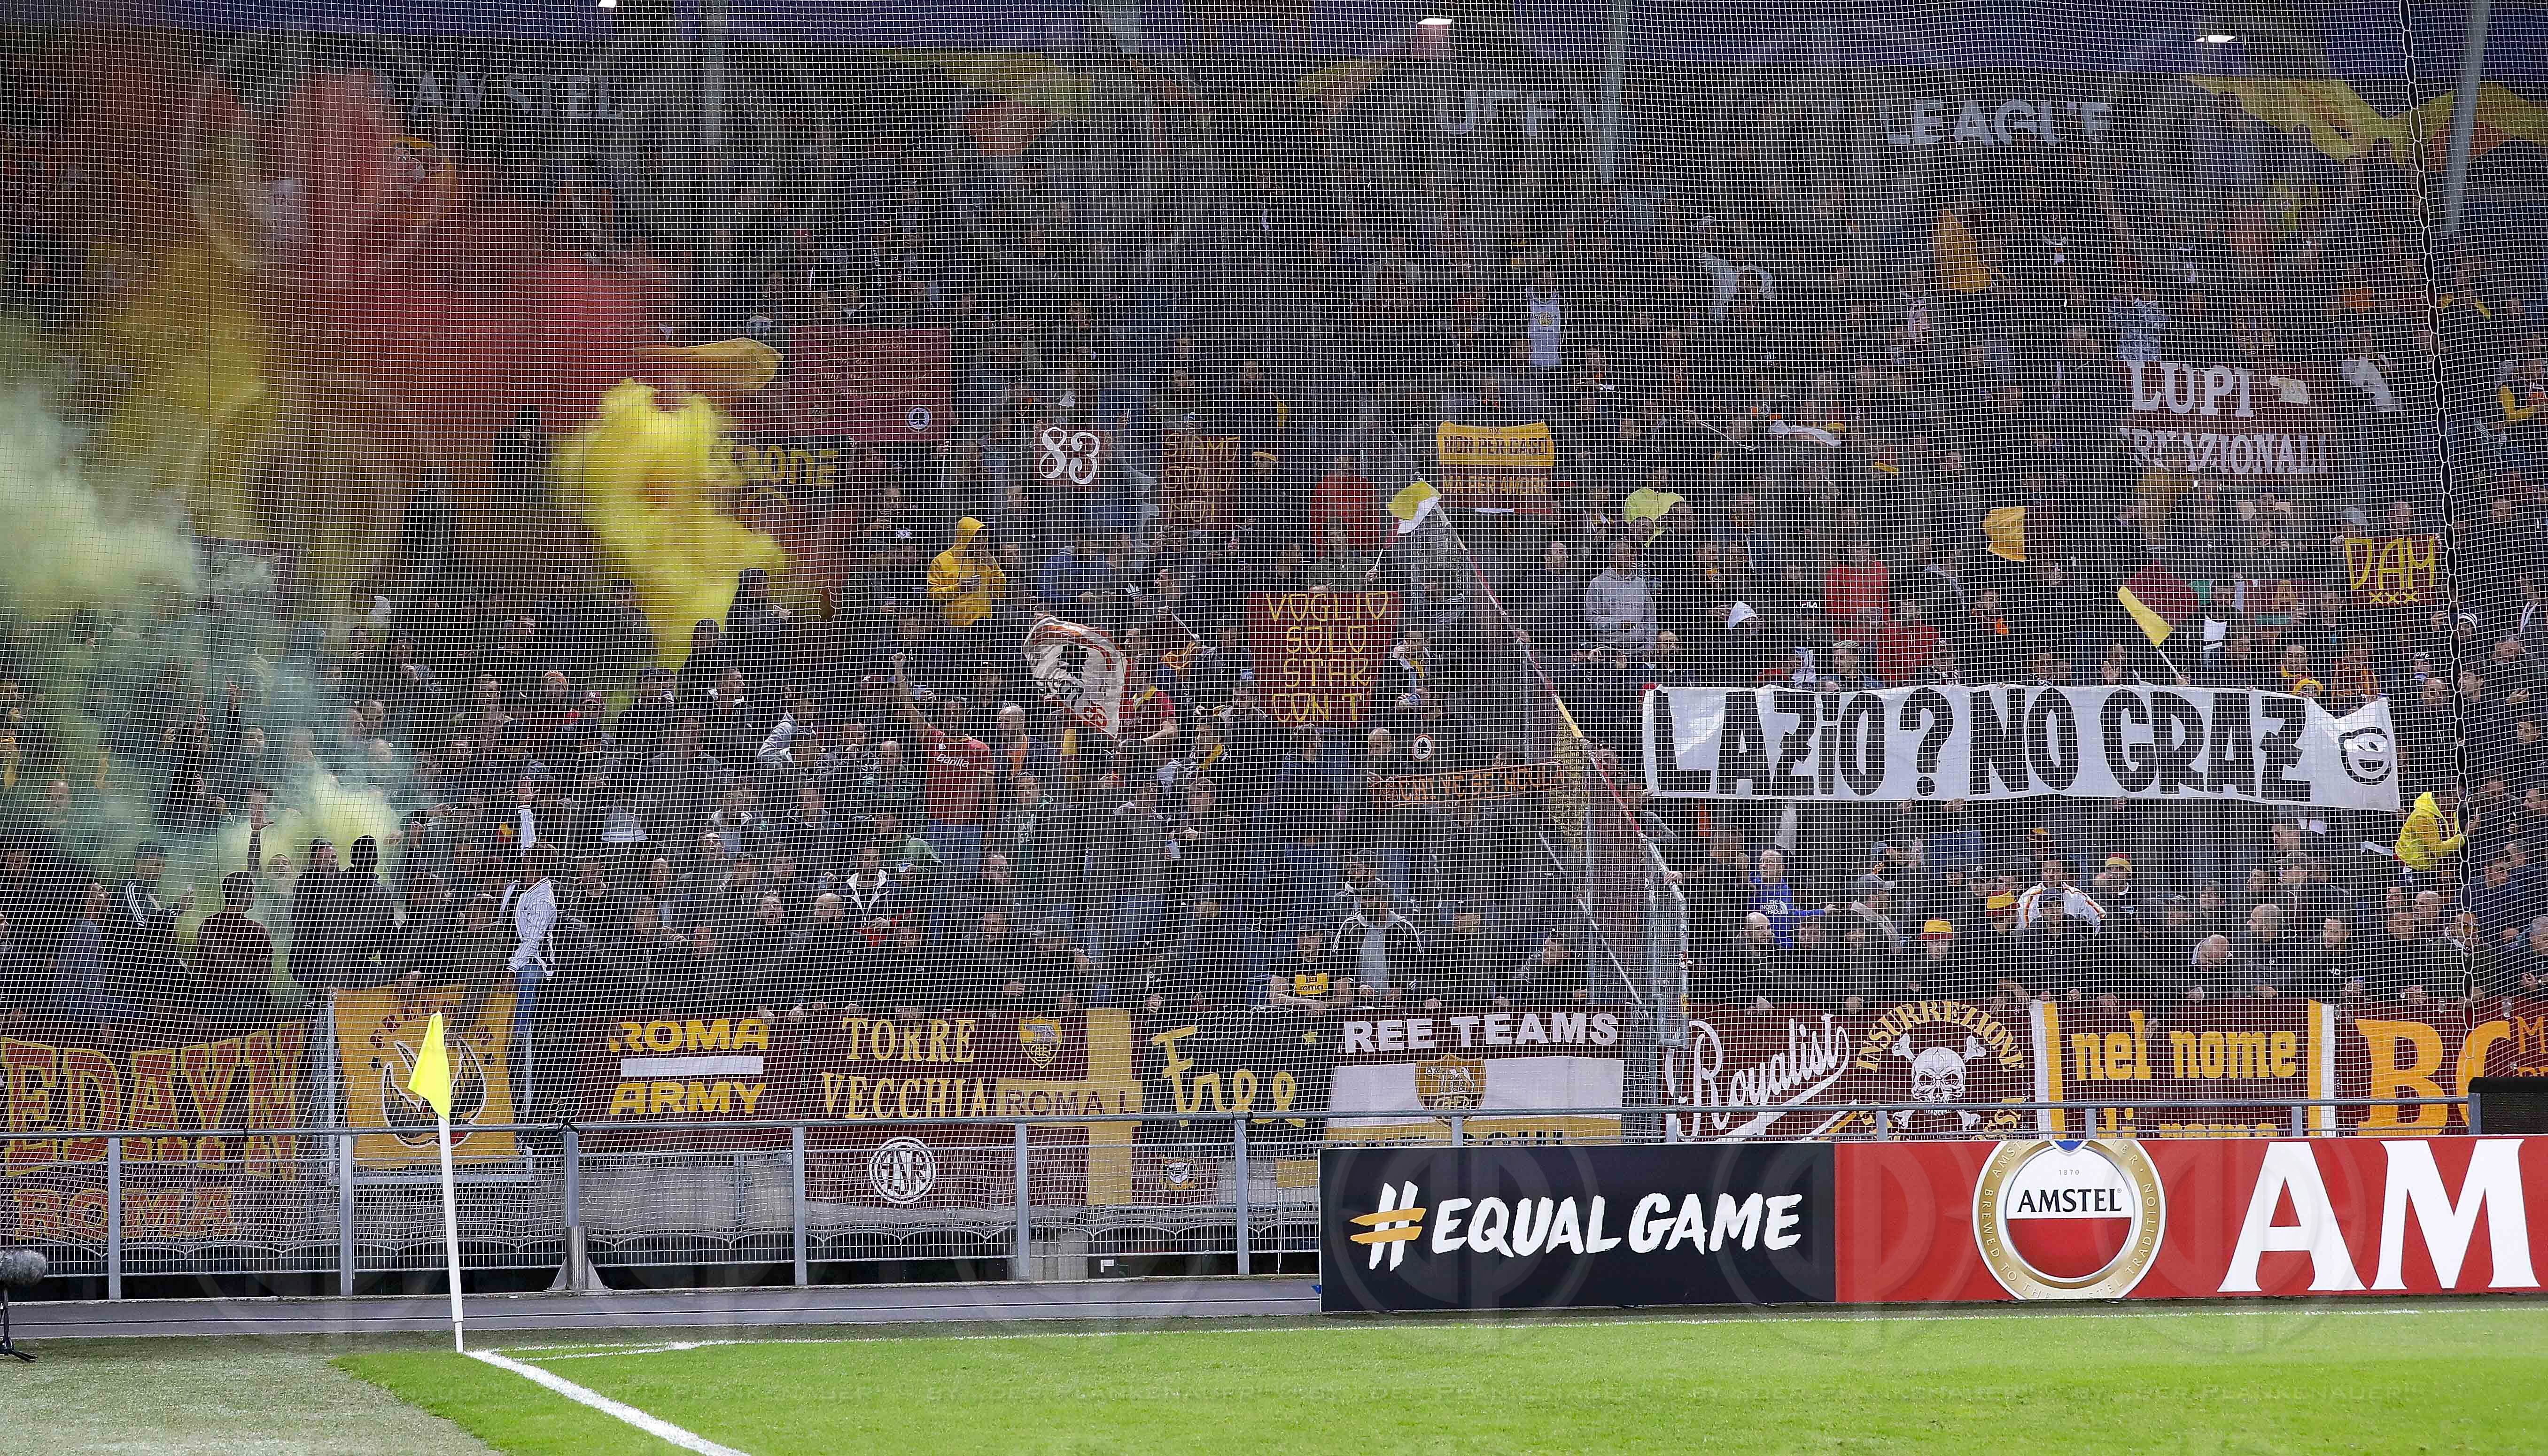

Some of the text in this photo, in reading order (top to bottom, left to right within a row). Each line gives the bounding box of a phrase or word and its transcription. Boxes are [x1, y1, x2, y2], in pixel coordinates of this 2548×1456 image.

[2127, 360, 2256, 417] LUPI
[1039, 426, 1100, 484] 83
[2345, 537, 2435, 590] DAM
[1265, 592, 1388, 621] VOGLIO
[1286, 625, 1367, 653] SOLO
[1969, 687, 2079, 796] NO
[2099, 688, 2312, 803] GRAZ
[607, 1018, 769, 1053] ROMA
[842, 1017, 976, 1063] TORRE
[1338, 1013, 1619, 1053] REE TEAMS
[1855, 1000, 2025, 1072] INSURREZIONE
[2071, 1010, 2297, 1081] nel nome
[608, 1081, 766, 1115] ARMY
[821, 1072, 988, 1119] VECCHIA
[1004, 1090, 1107, 1117] ROMA
[13, 1187, 235, 1240] ROMA
[1628, 1192, 1803, 1256] GAME
